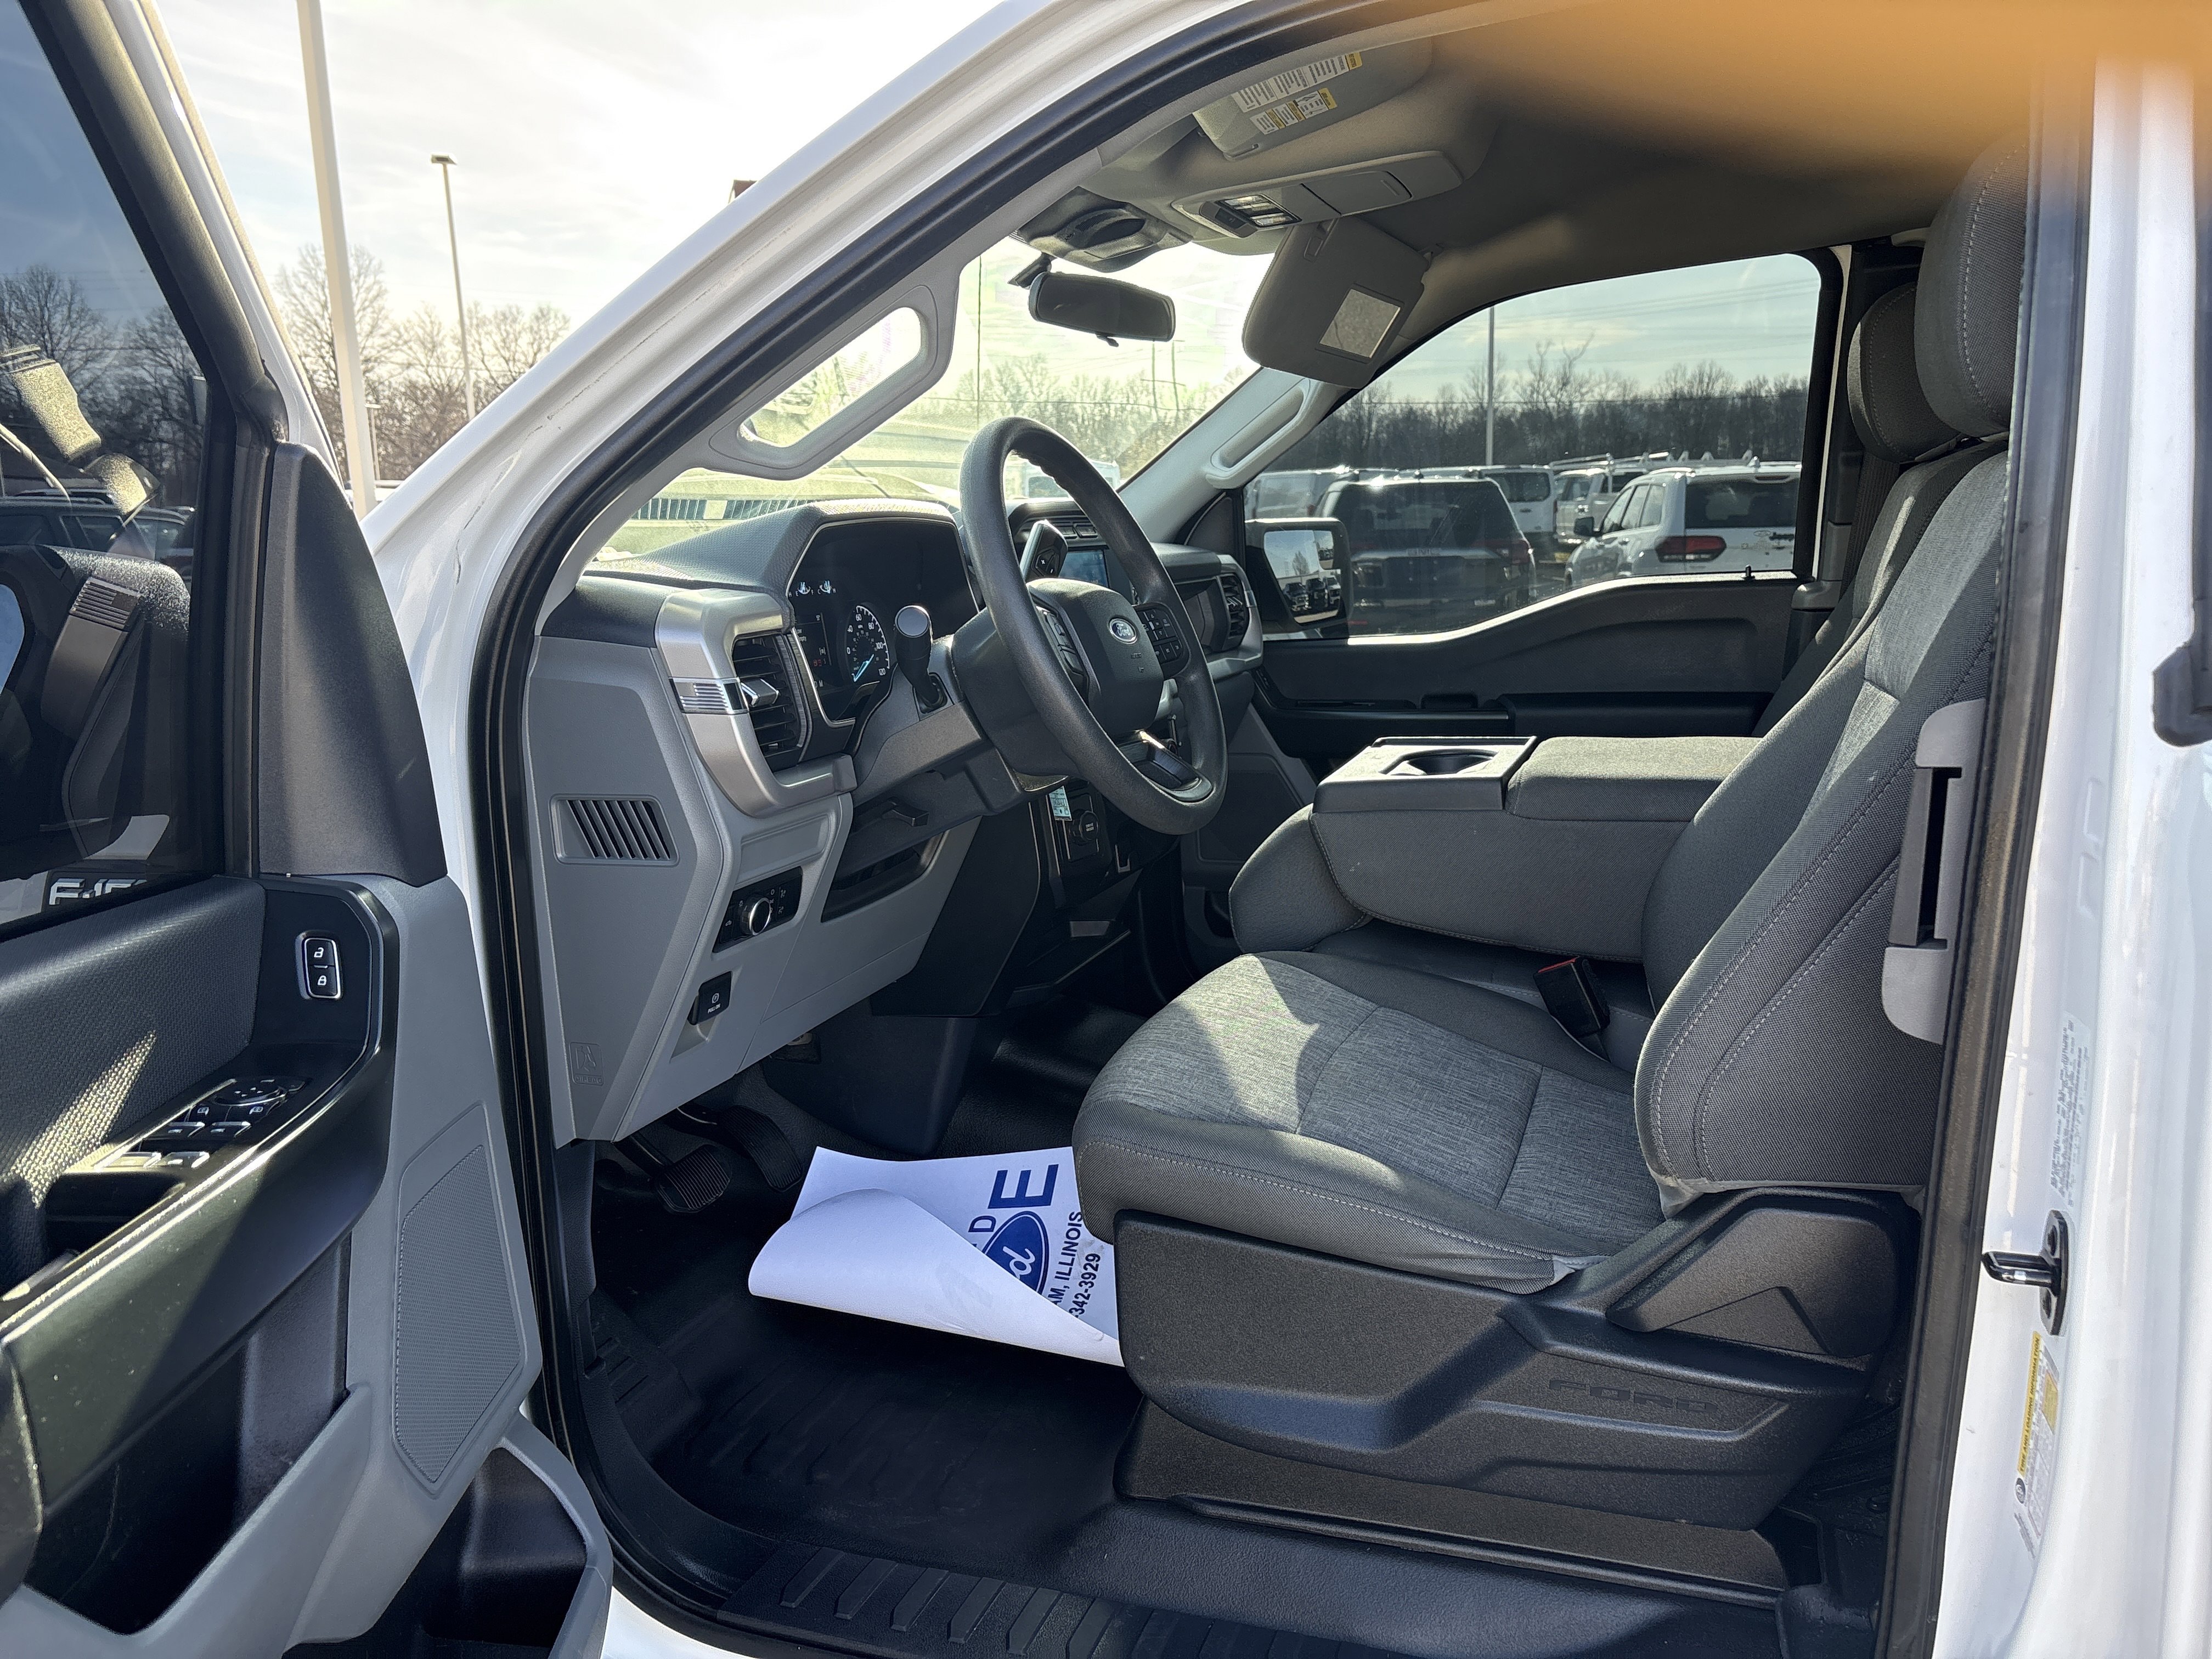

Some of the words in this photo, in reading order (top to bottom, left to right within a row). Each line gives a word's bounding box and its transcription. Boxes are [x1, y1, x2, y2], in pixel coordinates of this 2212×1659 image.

[855, 613, 862, 622] 60
[876, 641, 884, 650] 100
[1054, 1211, 1084, 1280] ILLINOIS
[1549, 1378, 1719, 1413] FORD
